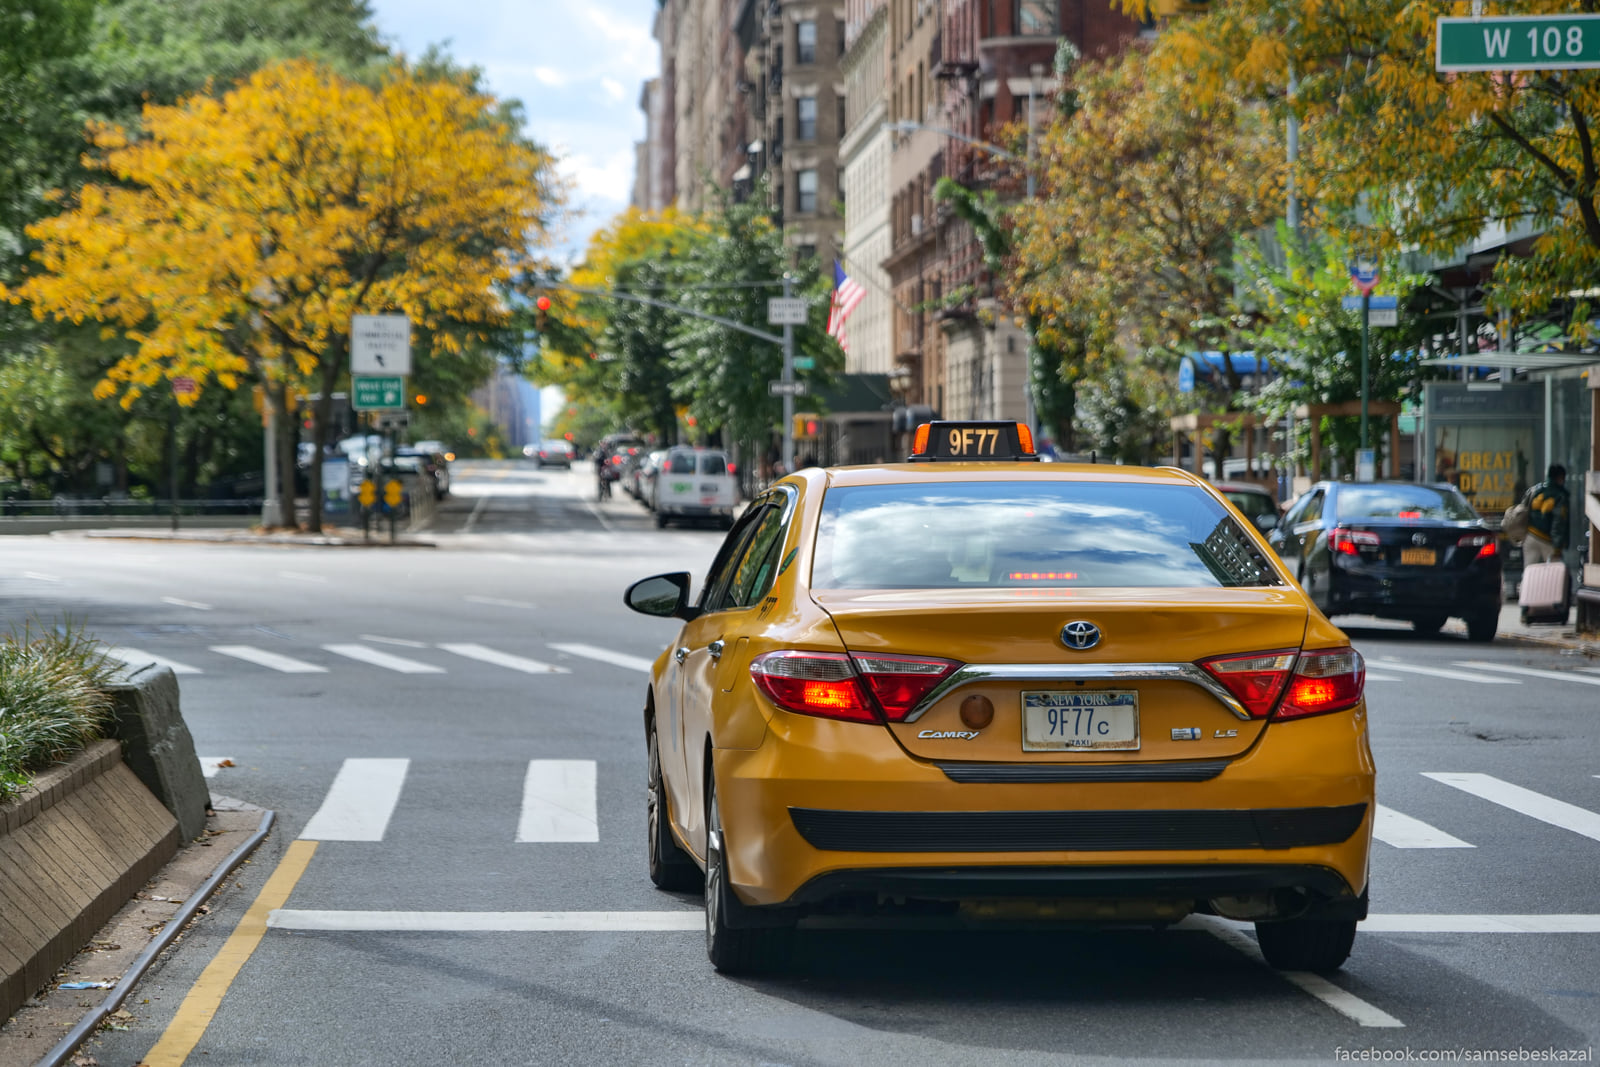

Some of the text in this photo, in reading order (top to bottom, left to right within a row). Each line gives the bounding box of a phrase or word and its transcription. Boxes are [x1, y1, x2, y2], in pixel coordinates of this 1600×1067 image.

[1483, 26, 1583, 58] W 108
[949, 428, 999, 455] 9F77
[1460, 451, 1513, 470] GREAT
[1460, 473, 1514, 492] DEALS
[1049, 694, 1109, 706] NEW YORK
